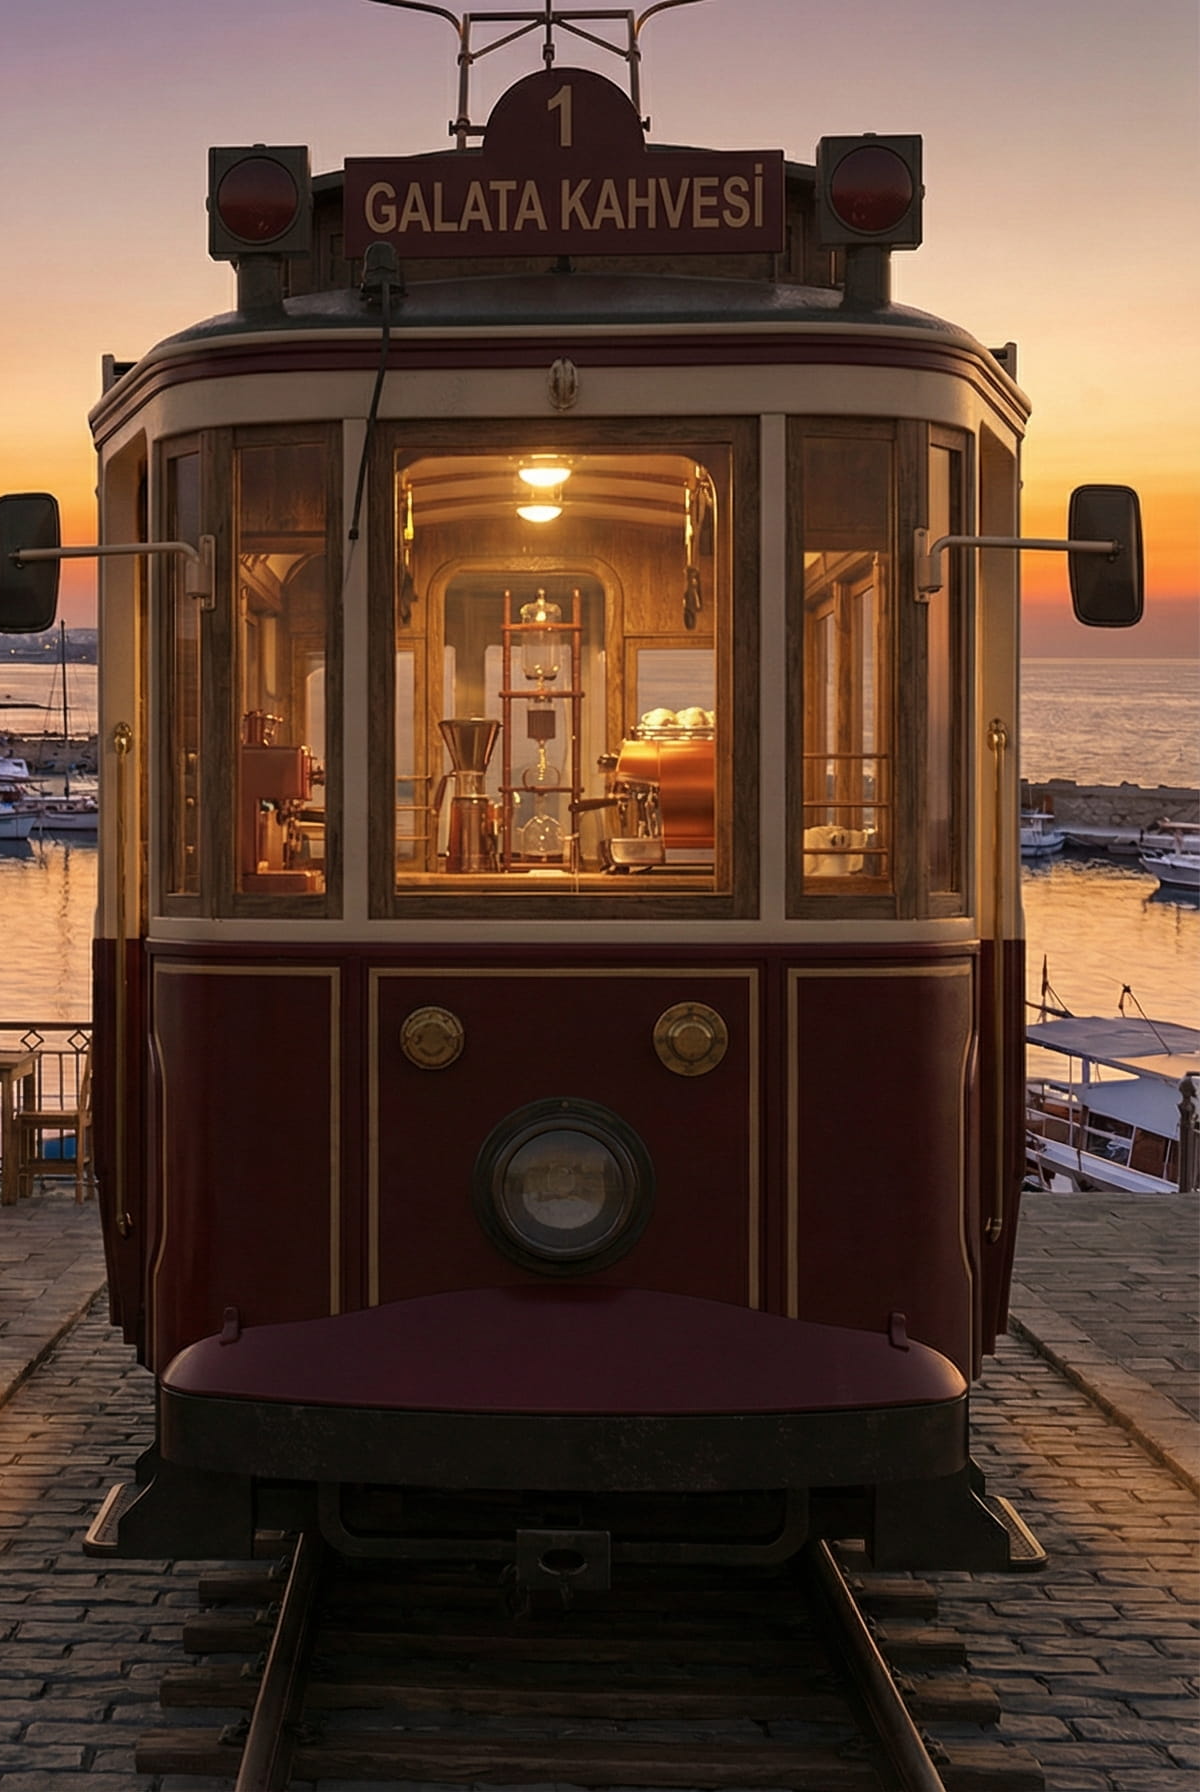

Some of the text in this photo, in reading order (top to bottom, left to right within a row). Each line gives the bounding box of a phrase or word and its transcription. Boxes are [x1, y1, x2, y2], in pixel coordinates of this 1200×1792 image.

[547, 85, 572, 146] 1
[364, 163, 764, 233] GALATA KAHVESİ
